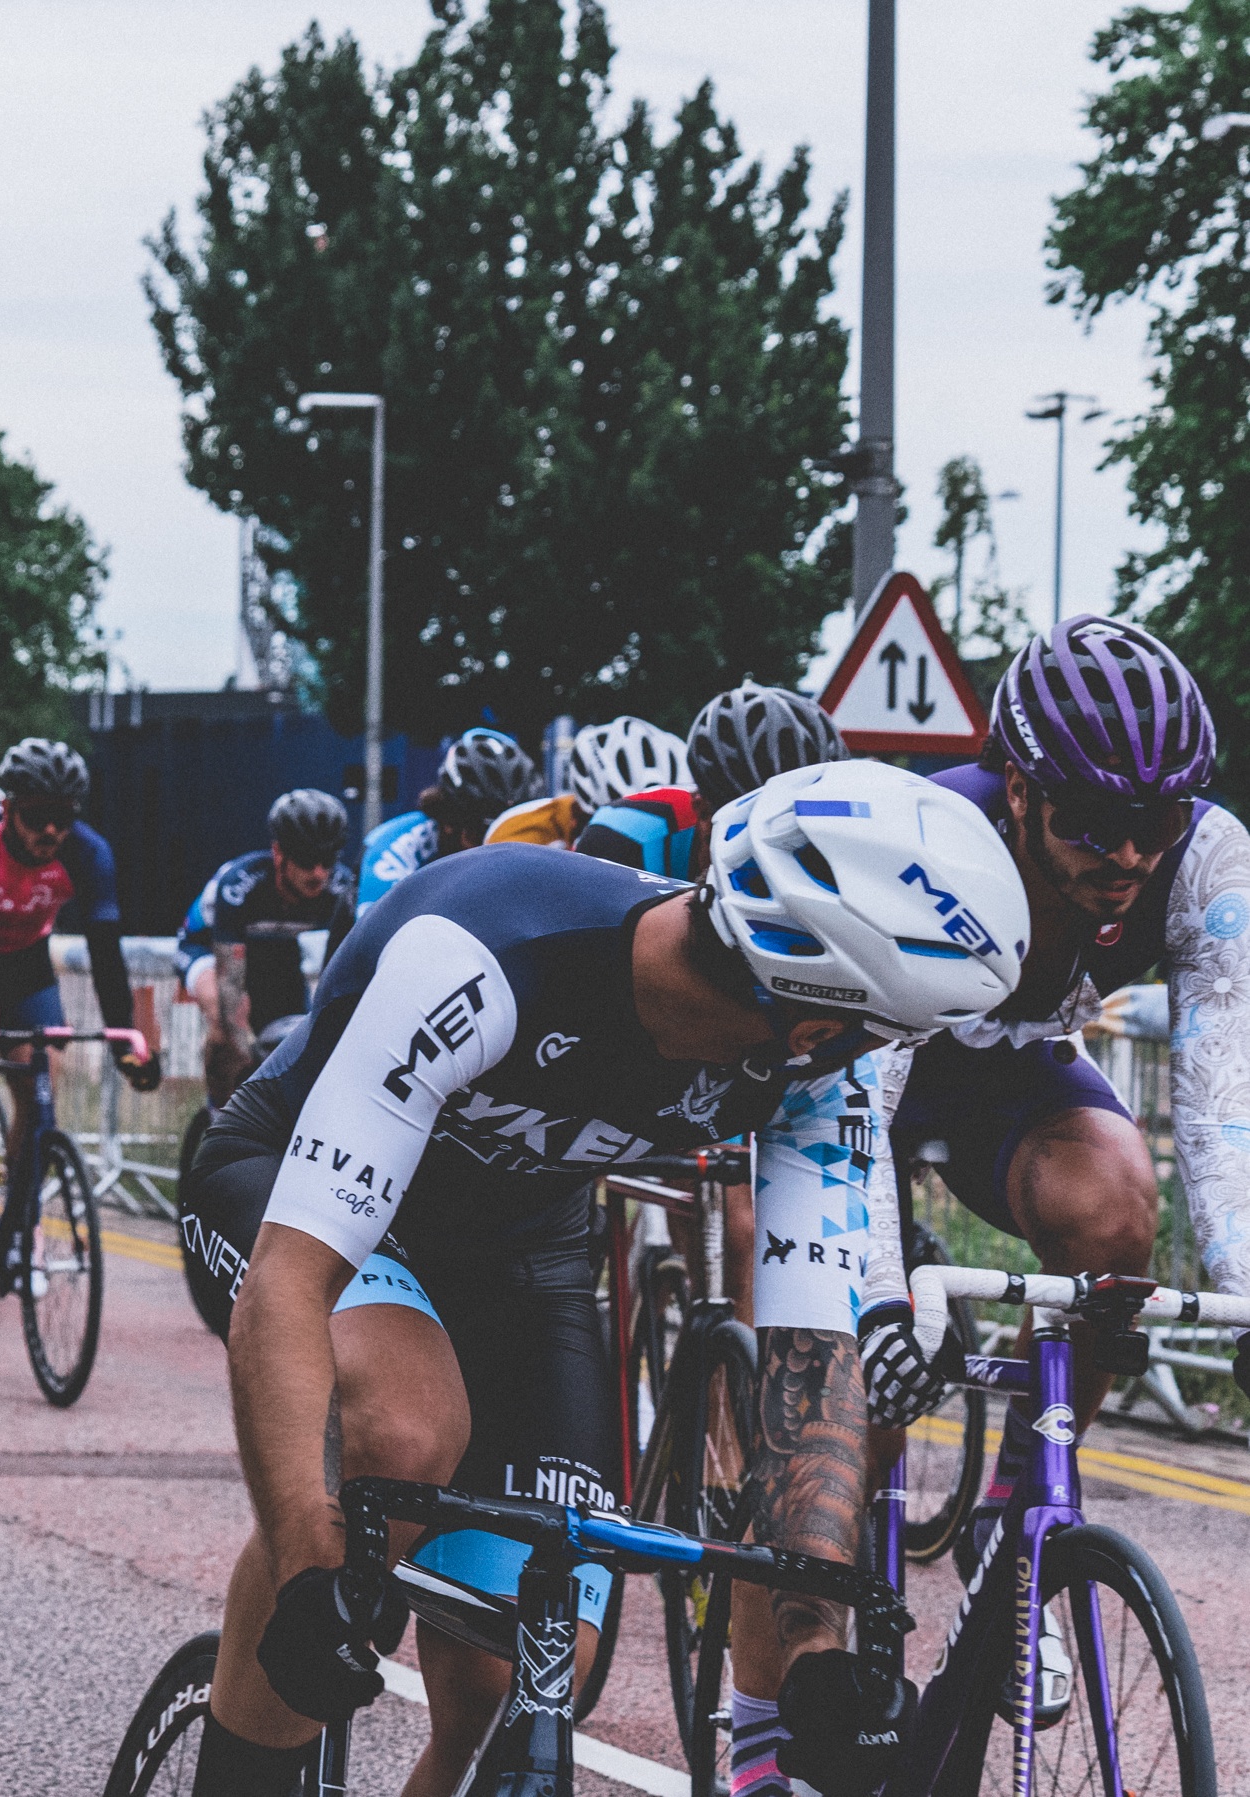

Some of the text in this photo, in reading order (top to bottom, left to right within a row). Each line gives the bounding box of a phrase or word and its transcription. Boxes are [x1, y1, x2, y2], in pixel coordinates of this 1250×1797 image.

[899, 863, 1003, 957] MET
[790, 983, 863, 1000] MARTINEZ
[382, 972, 486, 1103] MET
[456, 1090, 654, 1164] YKEL
[291, 1135, 405, 1204] RIVAL
